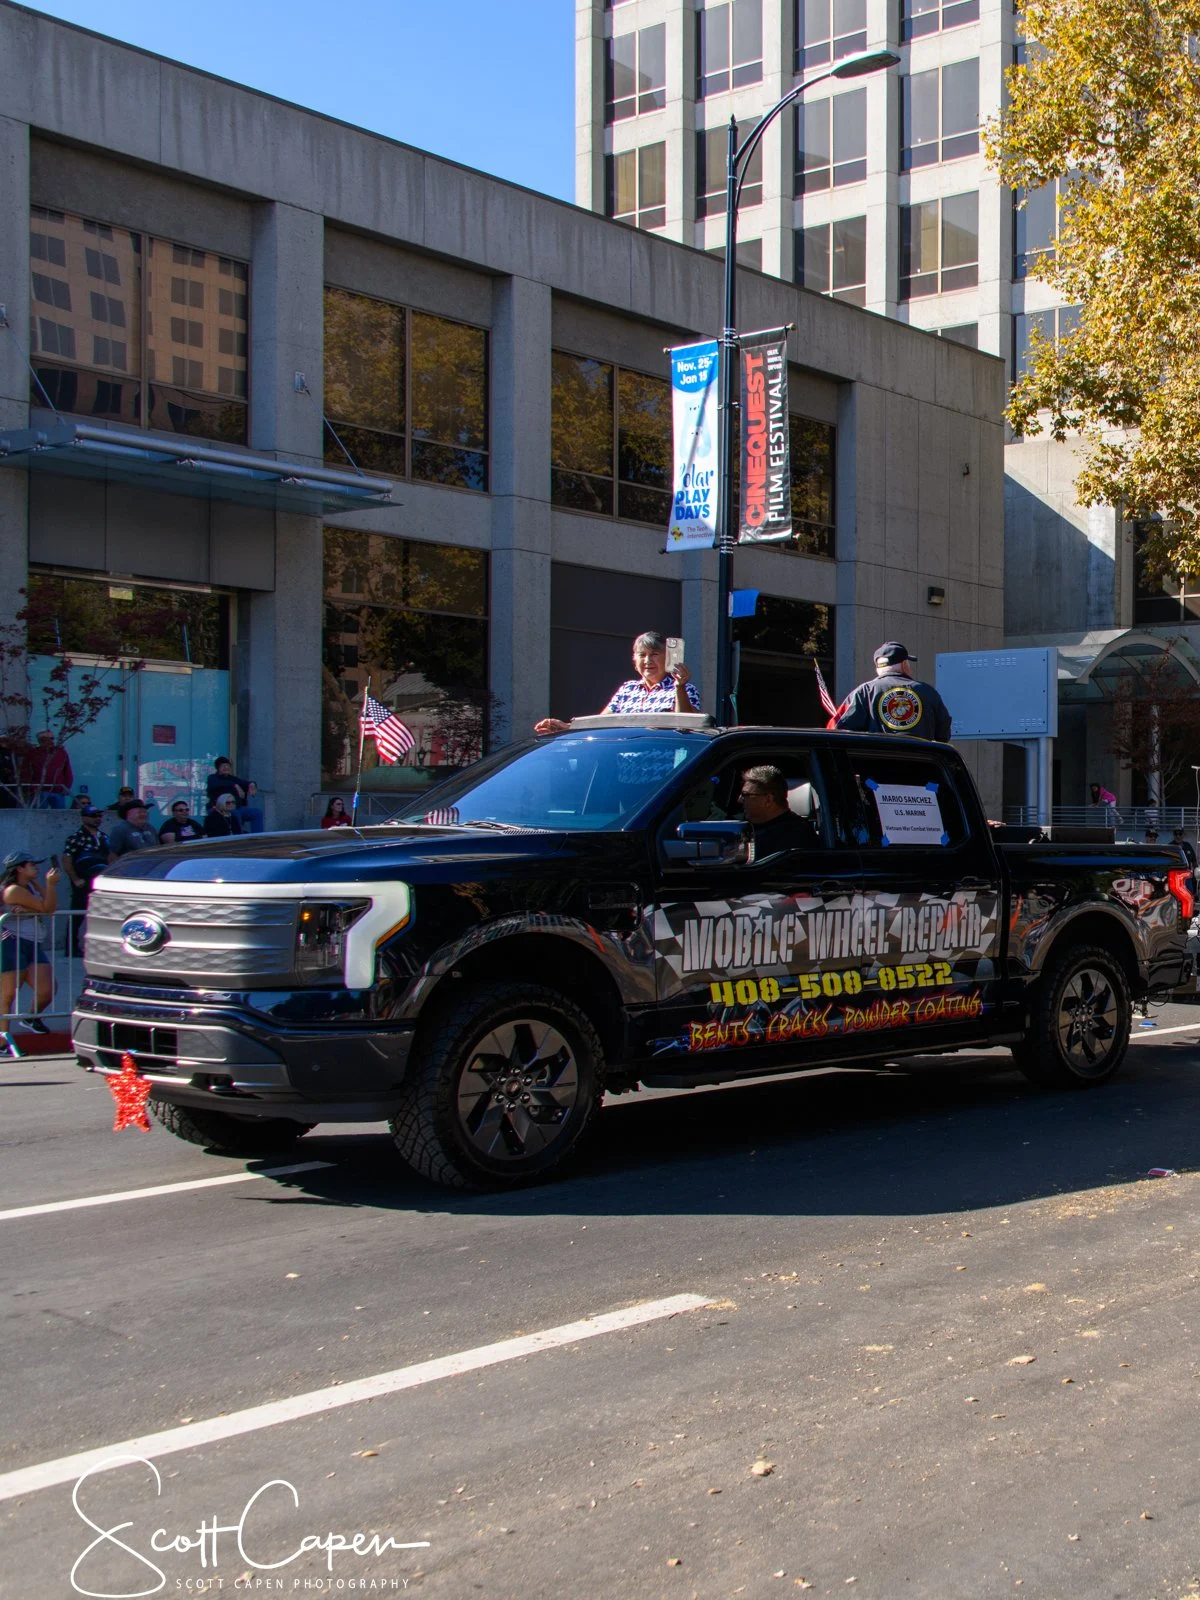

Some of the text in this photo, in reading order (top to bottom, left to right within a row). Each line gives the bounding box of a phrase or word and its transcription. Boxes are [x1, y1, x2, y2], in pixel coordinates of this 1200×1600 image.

[677, 361, 697, 373] Nov.
[680, 374, 698, 385] Jan
[768, 372, 785, 467] FESTIVAL
[745, 352, 768, 526] CINEQUEST
[675, 488, 710, 505] PLAY
[675, 504, 710, 520] DAYS
[881, 794, 932, 804] MARIO SANCHEZ
[807, 906, 890, 961] WHEEL
[711, 961, 954, 1007] 408-508-8522
[843, 999, 911, 1033] POWDER
[914, 991, 983, 1024] COATING
